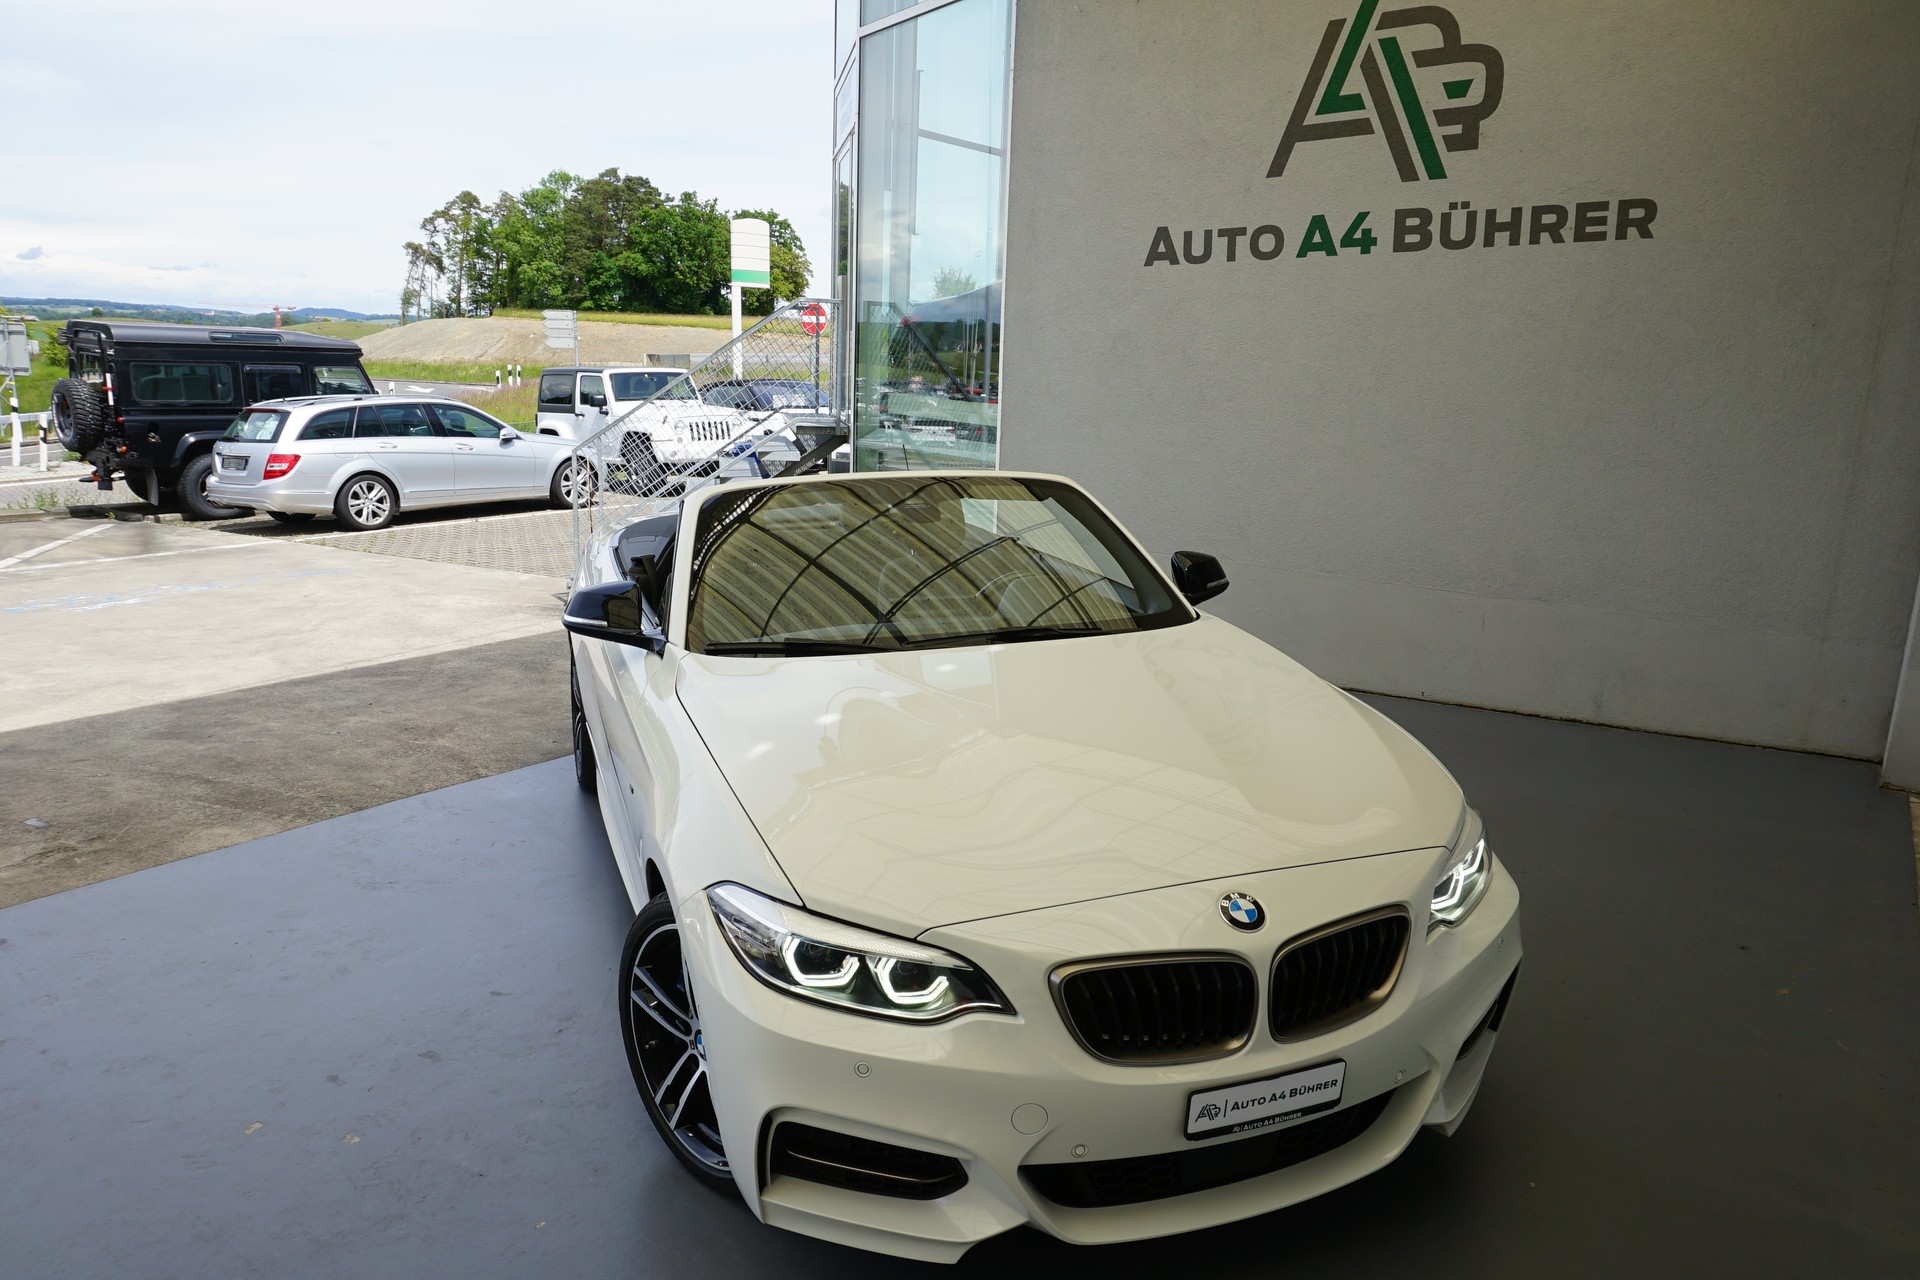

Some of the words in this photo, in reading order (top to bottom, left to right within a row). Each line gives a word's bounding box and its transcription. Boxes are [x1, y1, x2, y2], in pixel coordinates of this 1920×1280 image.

[1143, 224, 1285, 267] AUTO
[1296, 211, 1378, 258] A4
[1391, 198, 1658, 253] BÜHRER
[1221, 892, 1255, 907] BMW
[1230, 1096, 1267, 1112] AUTO
[1268, 1090, 1287, 1104] A4
[1289, 1079, 1339, 1099] BÜHRER
[1243, 1121, 1263, 1131] AUTO
[1263, 1118, 1274, 1126] A4
